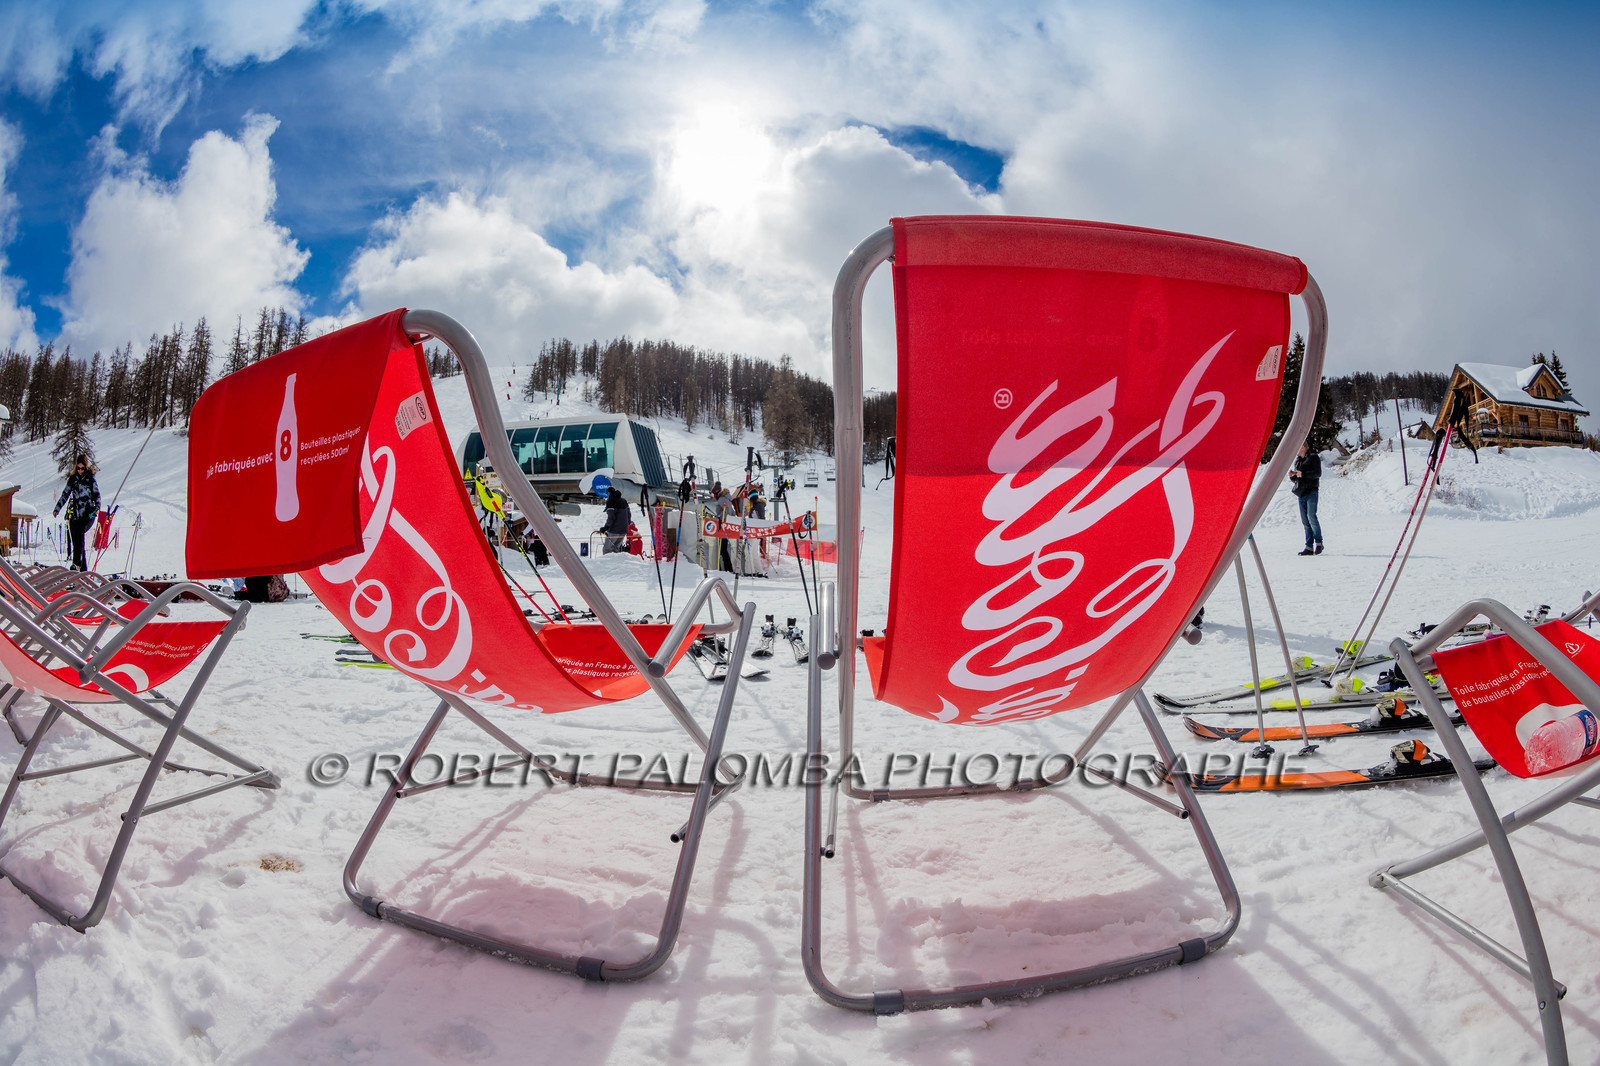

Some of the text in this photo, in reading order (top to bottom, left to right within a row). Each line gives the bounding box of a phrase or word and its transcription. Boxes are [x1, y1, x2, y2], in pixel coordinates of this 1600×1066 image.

[279, 429, 292, 462] 8
[300, 425, 361, 451] Bouteilles plastiques
[214, 457, 256, 474] fabriquée
[256, 451, 274, 466] avec
[300, 452, 331, 467] recyclées
[722, 523, 757, 534] PASSGE
[571, 668, 610, 678] plastiques
[594, 661, 621, 670] France
[1453, 685, 1475, 696] Toile
[1474, 673, 1510, 691] fabriquée
[1509, 668, 1520, 679] en
[1517, 661, 1539, 671] France
[1461, 699, 1472, 708] de
[1471, 688, 1510, 705] bouteilles
[1508, 672, 1541, 695] plastiques
